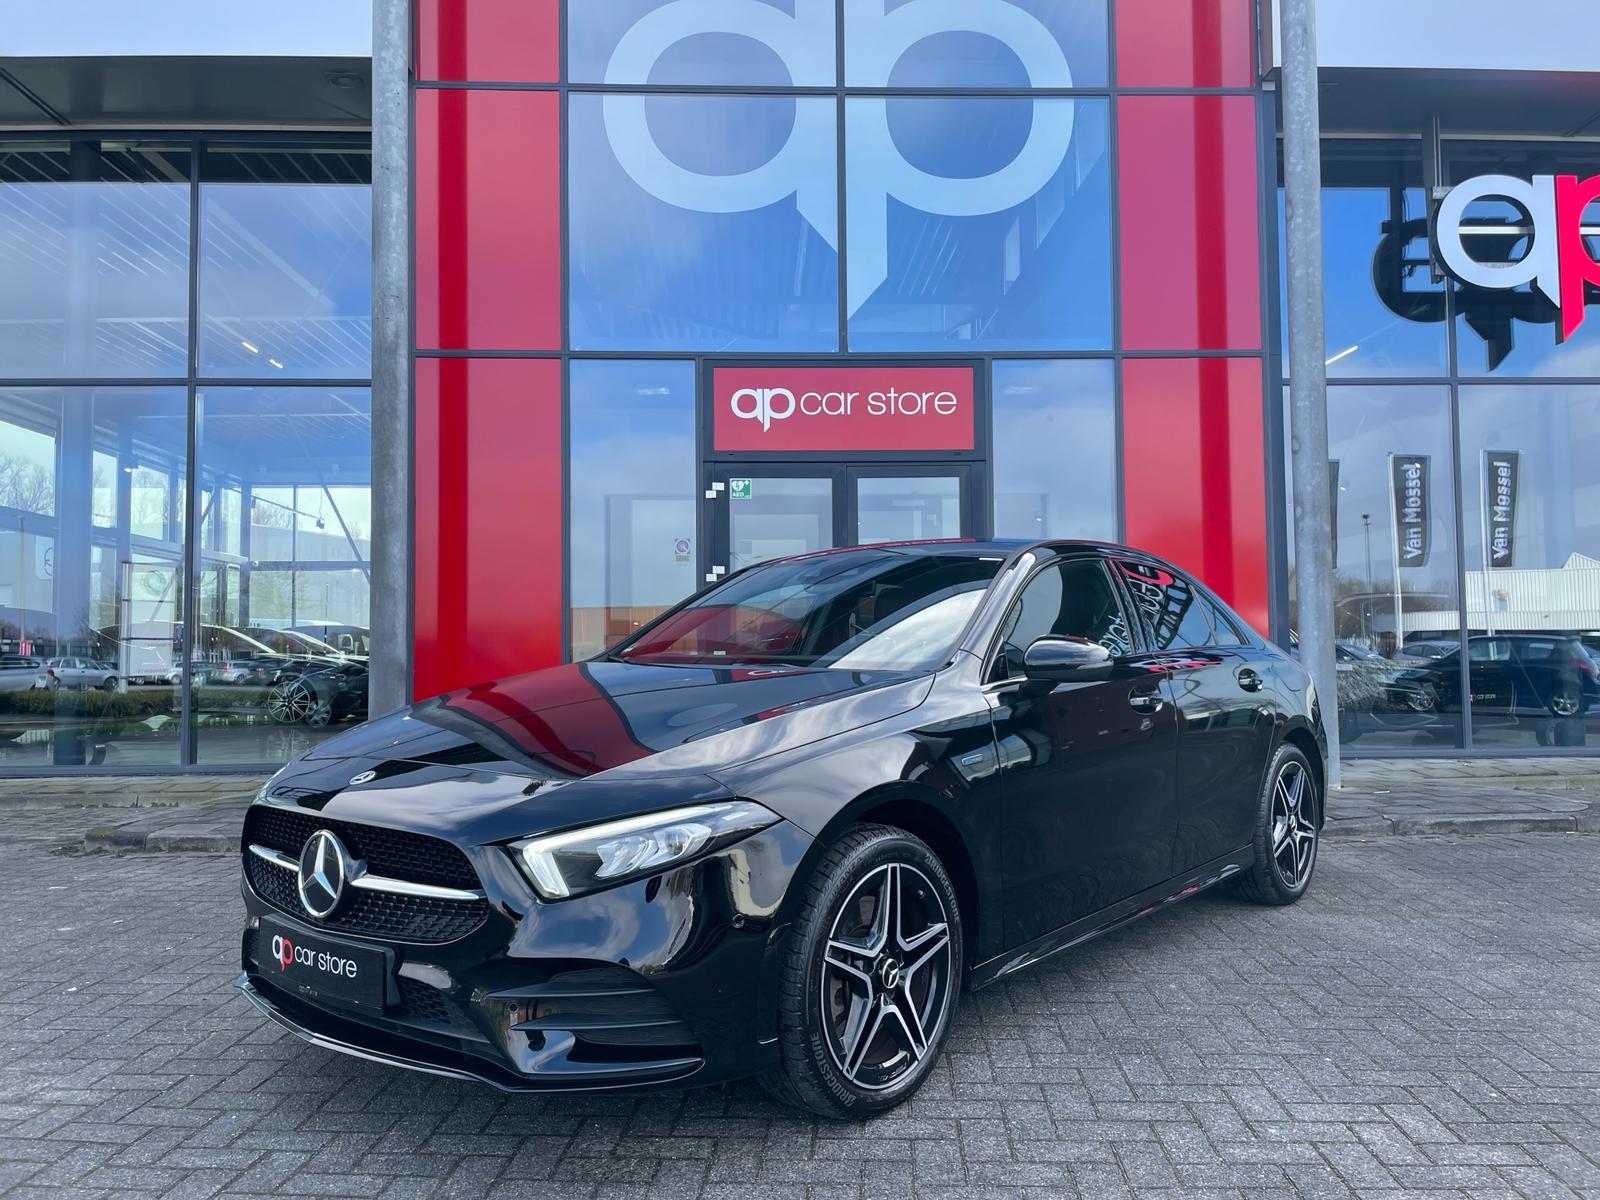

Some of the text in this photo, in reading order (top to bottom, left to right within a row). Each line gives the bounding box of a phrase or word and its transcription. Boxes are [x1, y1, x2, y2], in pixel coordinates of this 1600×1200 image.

[603, 0, 1074, 320] ap
[731, 387, 958, 432] ap car store
[1400, 462, 1422, 559] Van Mossel
[1492, 461, 1512, 559] Van Mossel
[923, 852, 961, 923] BRIDGESTONE
[272, 934, 357, 978] ap car store
[810, 1031, 857, 1107] BRIDGESTONE
